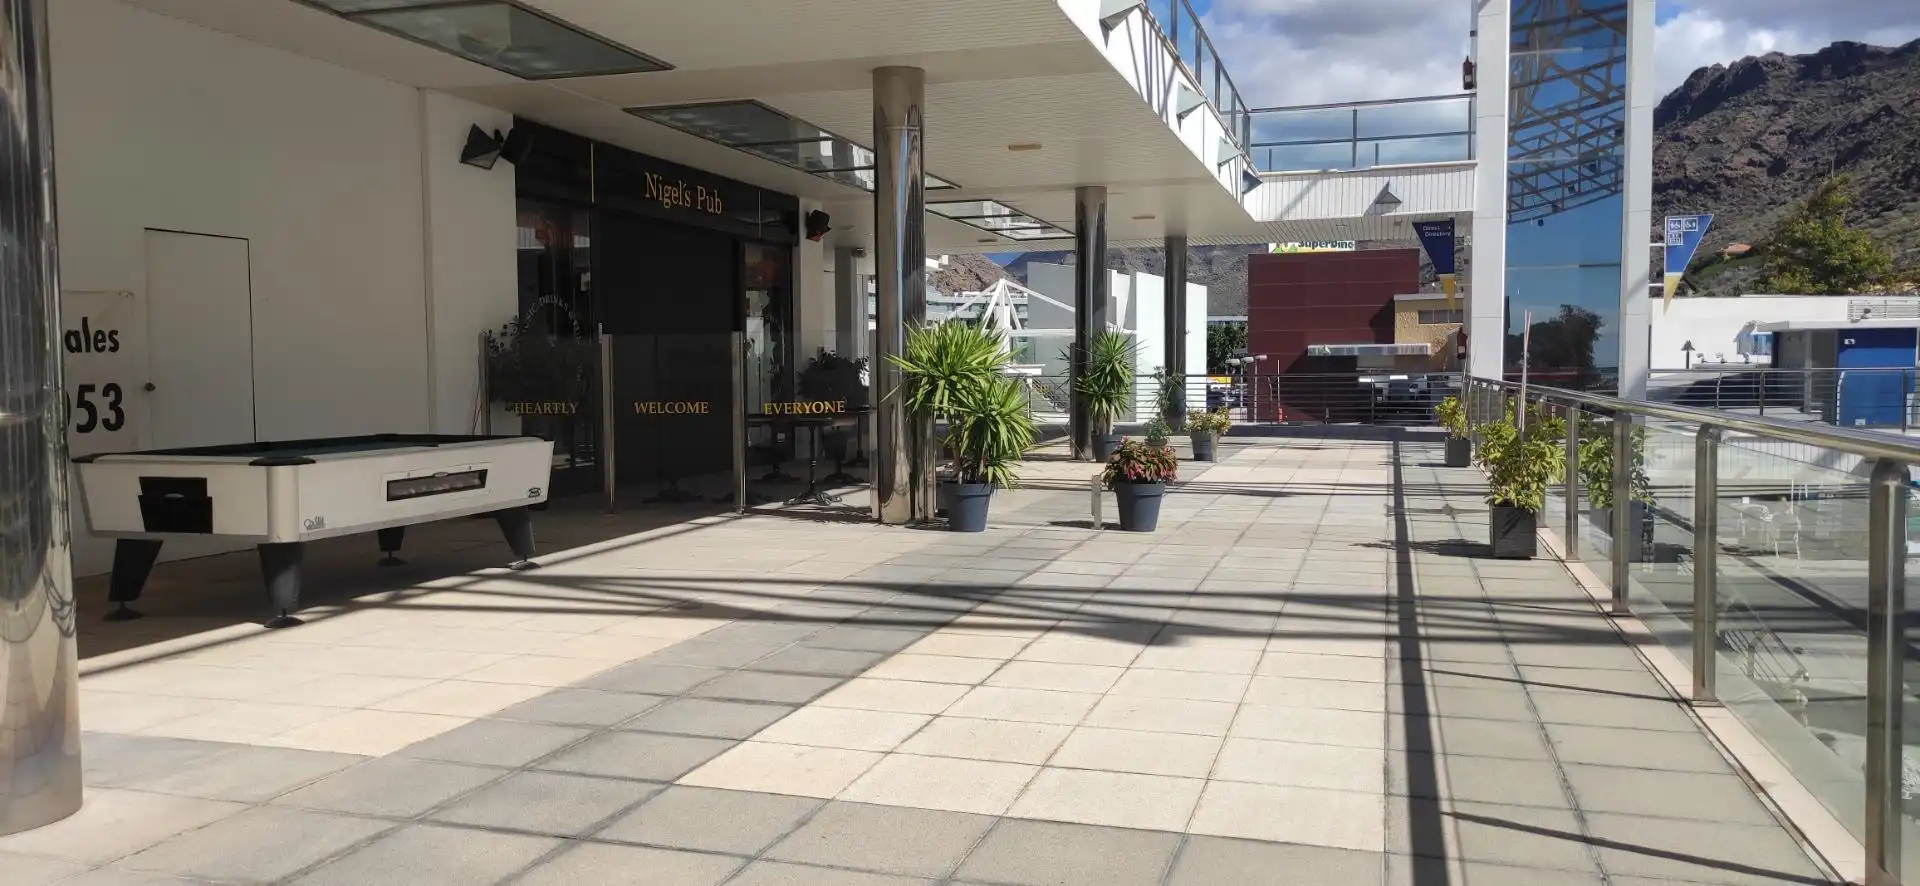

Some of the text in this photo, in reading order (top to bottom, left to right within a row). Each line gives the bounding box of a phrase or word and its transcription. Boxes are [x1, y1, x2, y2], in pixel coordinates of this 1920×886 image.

[644, 172, 722, 214] Nigel's Pub
[66, 382, 125, 434] 53
[634, 401, 709, 414] WELCOME
[763, 400, 846, 415] EVERYONE
